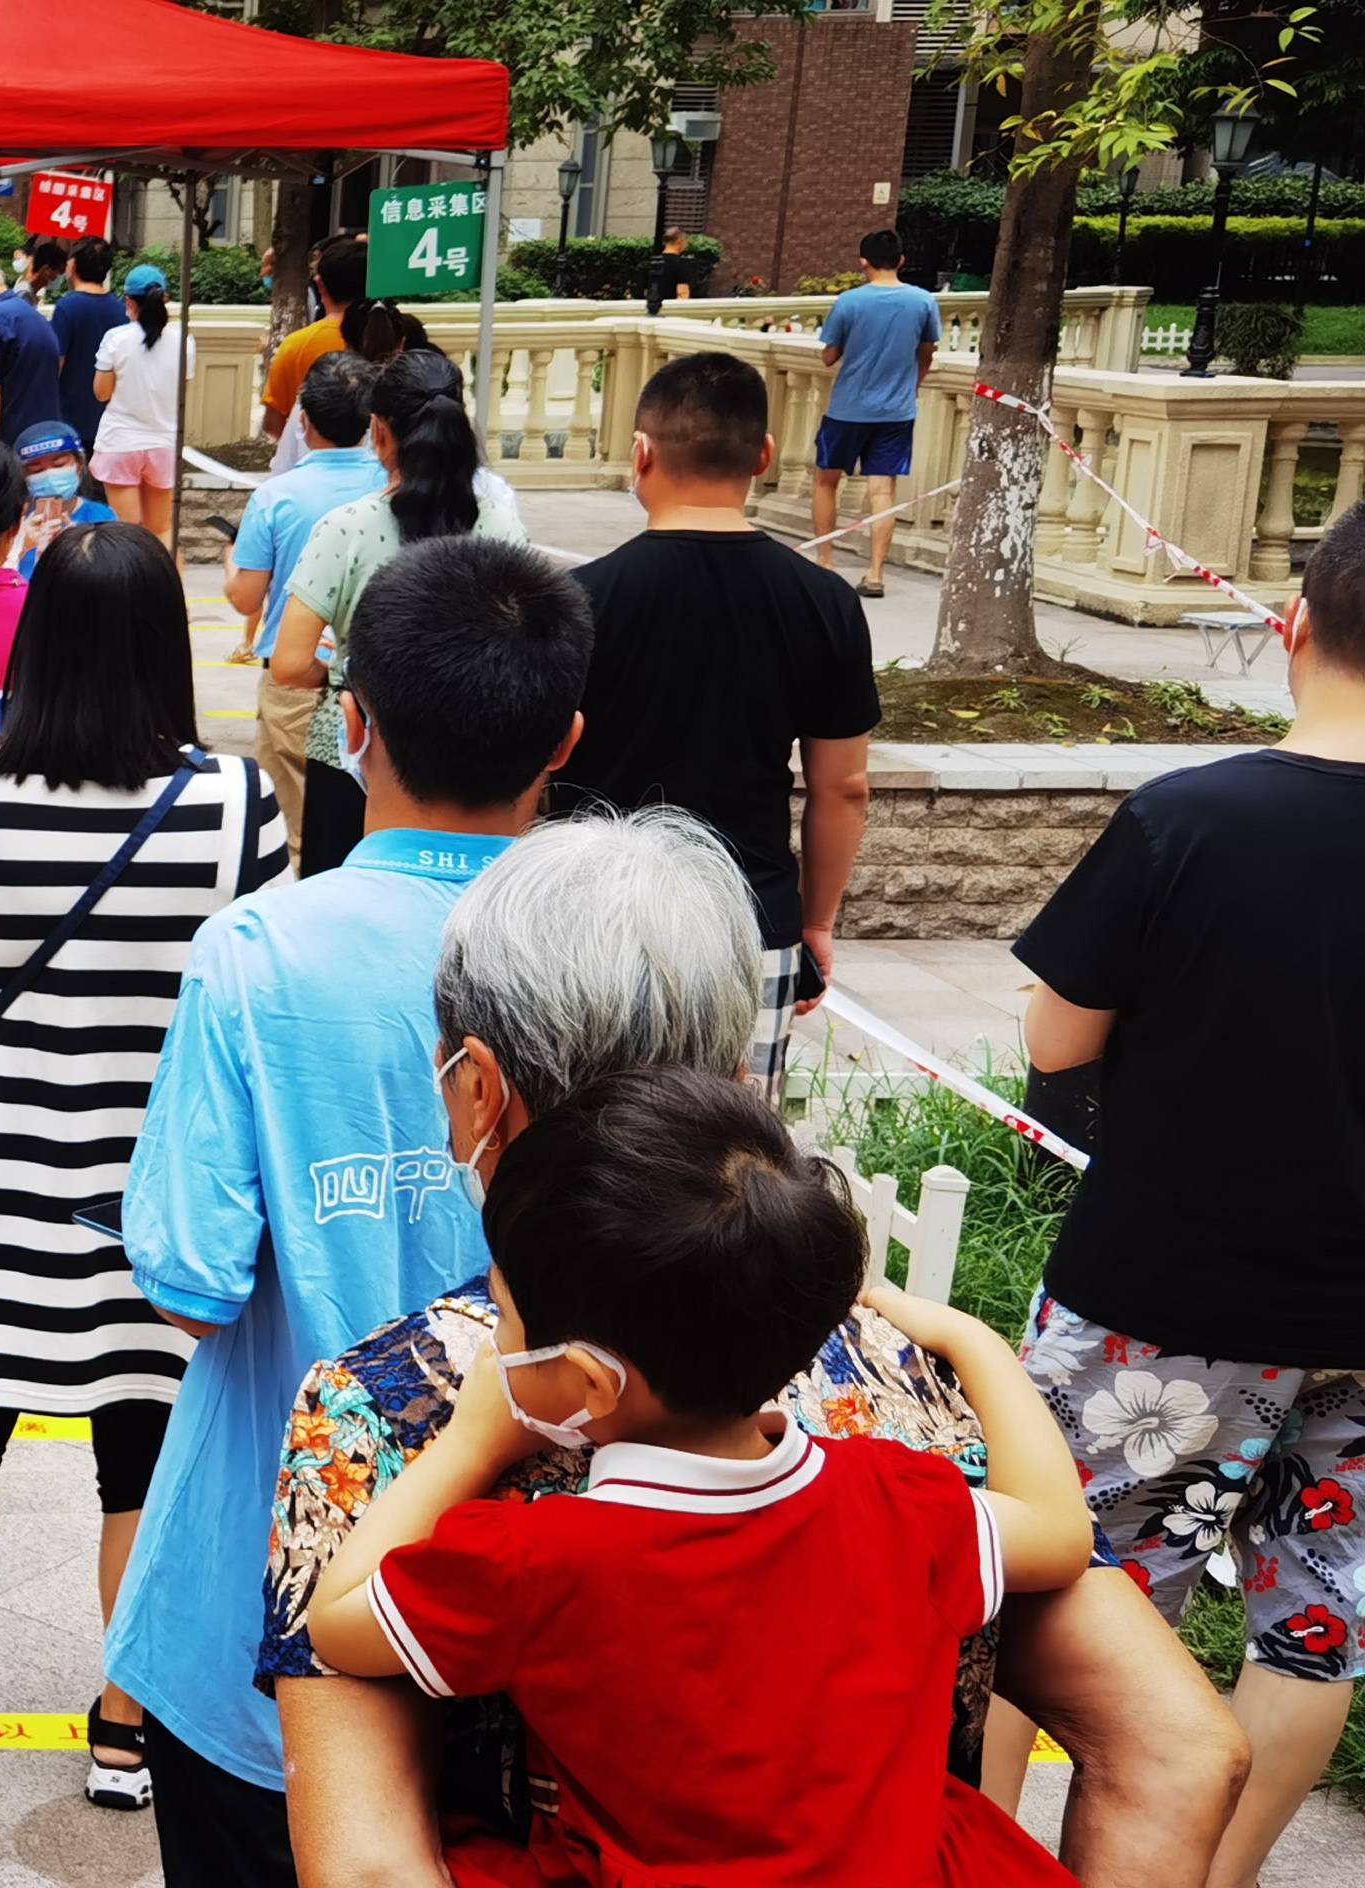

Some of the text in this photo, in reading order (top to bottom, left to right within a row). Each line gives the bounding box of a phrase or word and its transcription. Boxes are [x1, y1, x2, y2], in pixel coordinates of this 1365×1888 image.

[50, 200, 88, 232] 4号
[380, 192, 486, 224] 信息采集区
[407, 227, 469, 277] 4号
[419, 850, 468, 869] SHI
